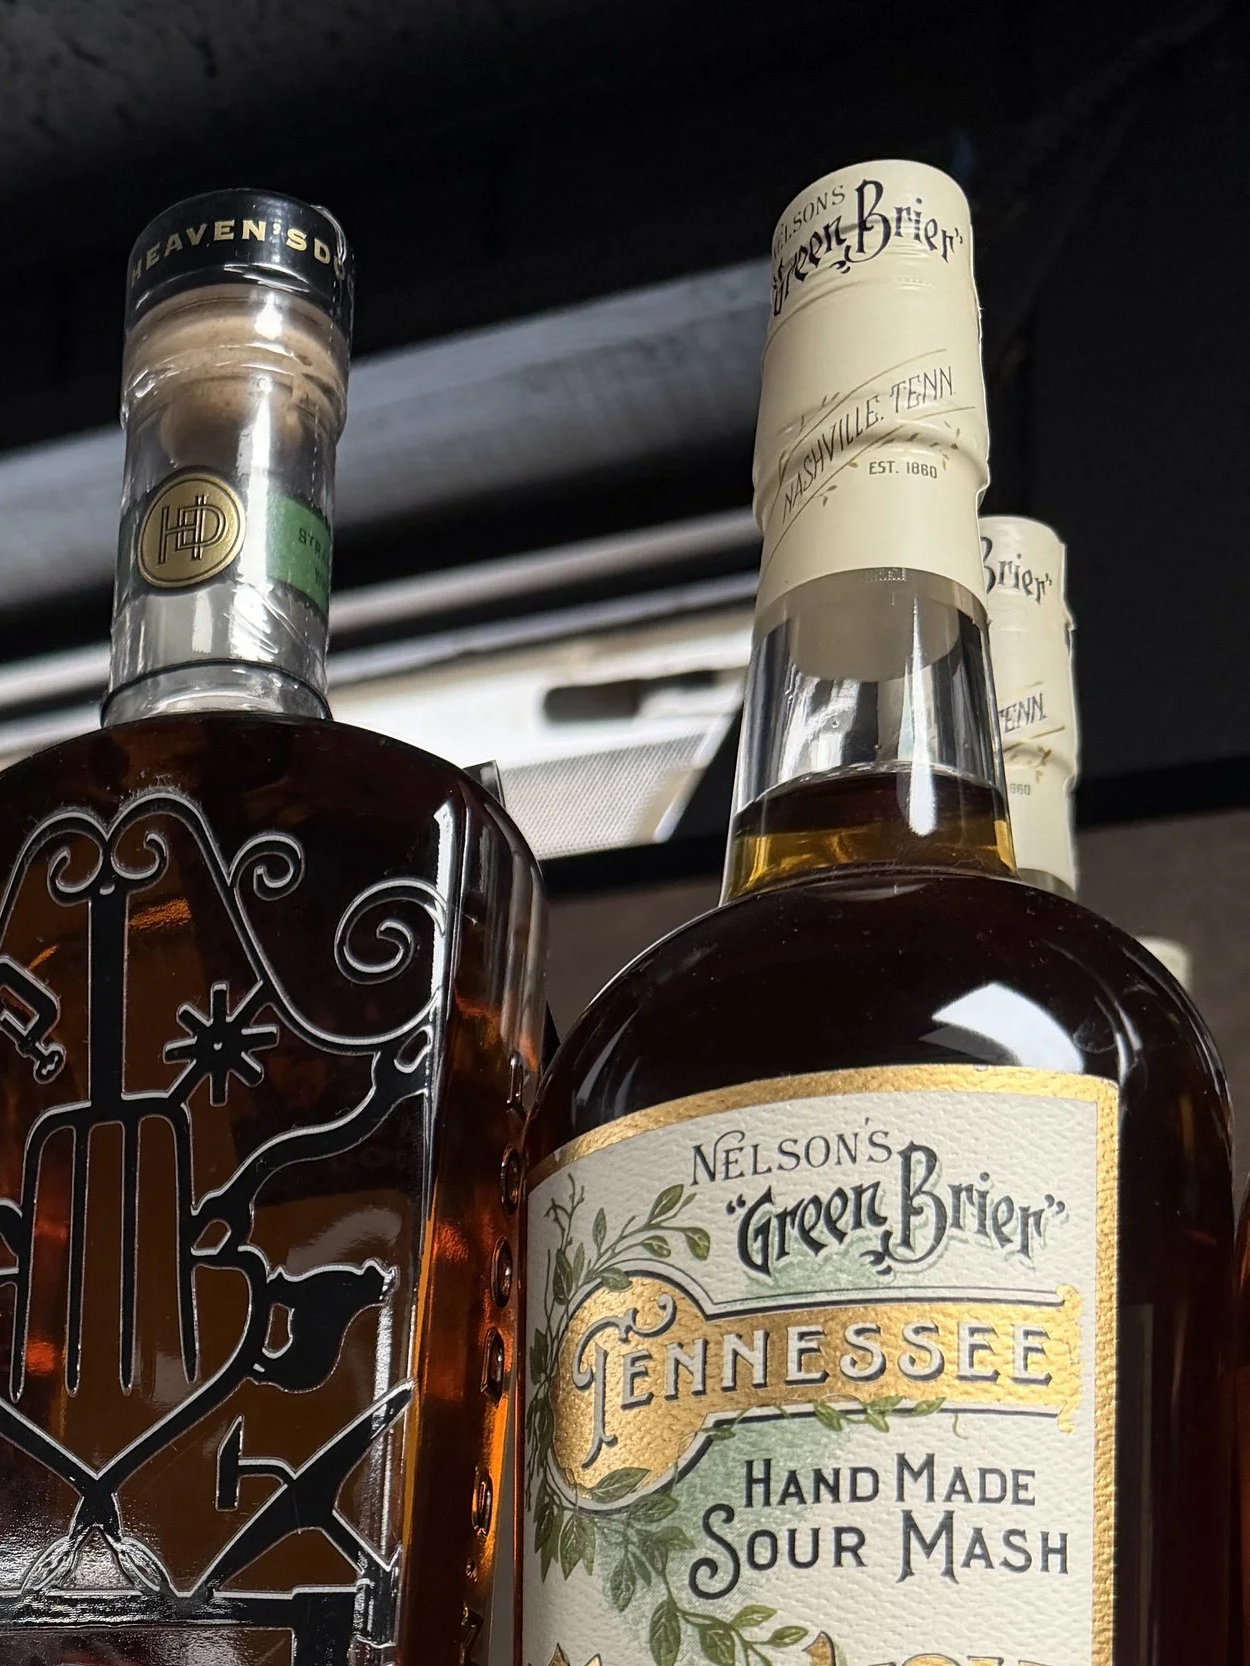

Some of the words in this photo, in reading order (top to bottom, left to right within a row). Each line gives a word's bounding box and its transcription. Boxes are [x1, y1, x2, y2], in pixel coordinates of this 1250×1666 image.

[869, 460, 899, 475] EST.
[906, 462, 938, 479] 1860
[690, 1118, 892, 1188] NELSON'S
[572, 1292, 1053, 1470] TENNESSEE
[744, 1457, 880, 1509] HAND
[896, 1451, 1037, 1506] MADE
[688, 1503, 867, 1601] SOUR
[896, 1509, 1070, 1584] MASH
